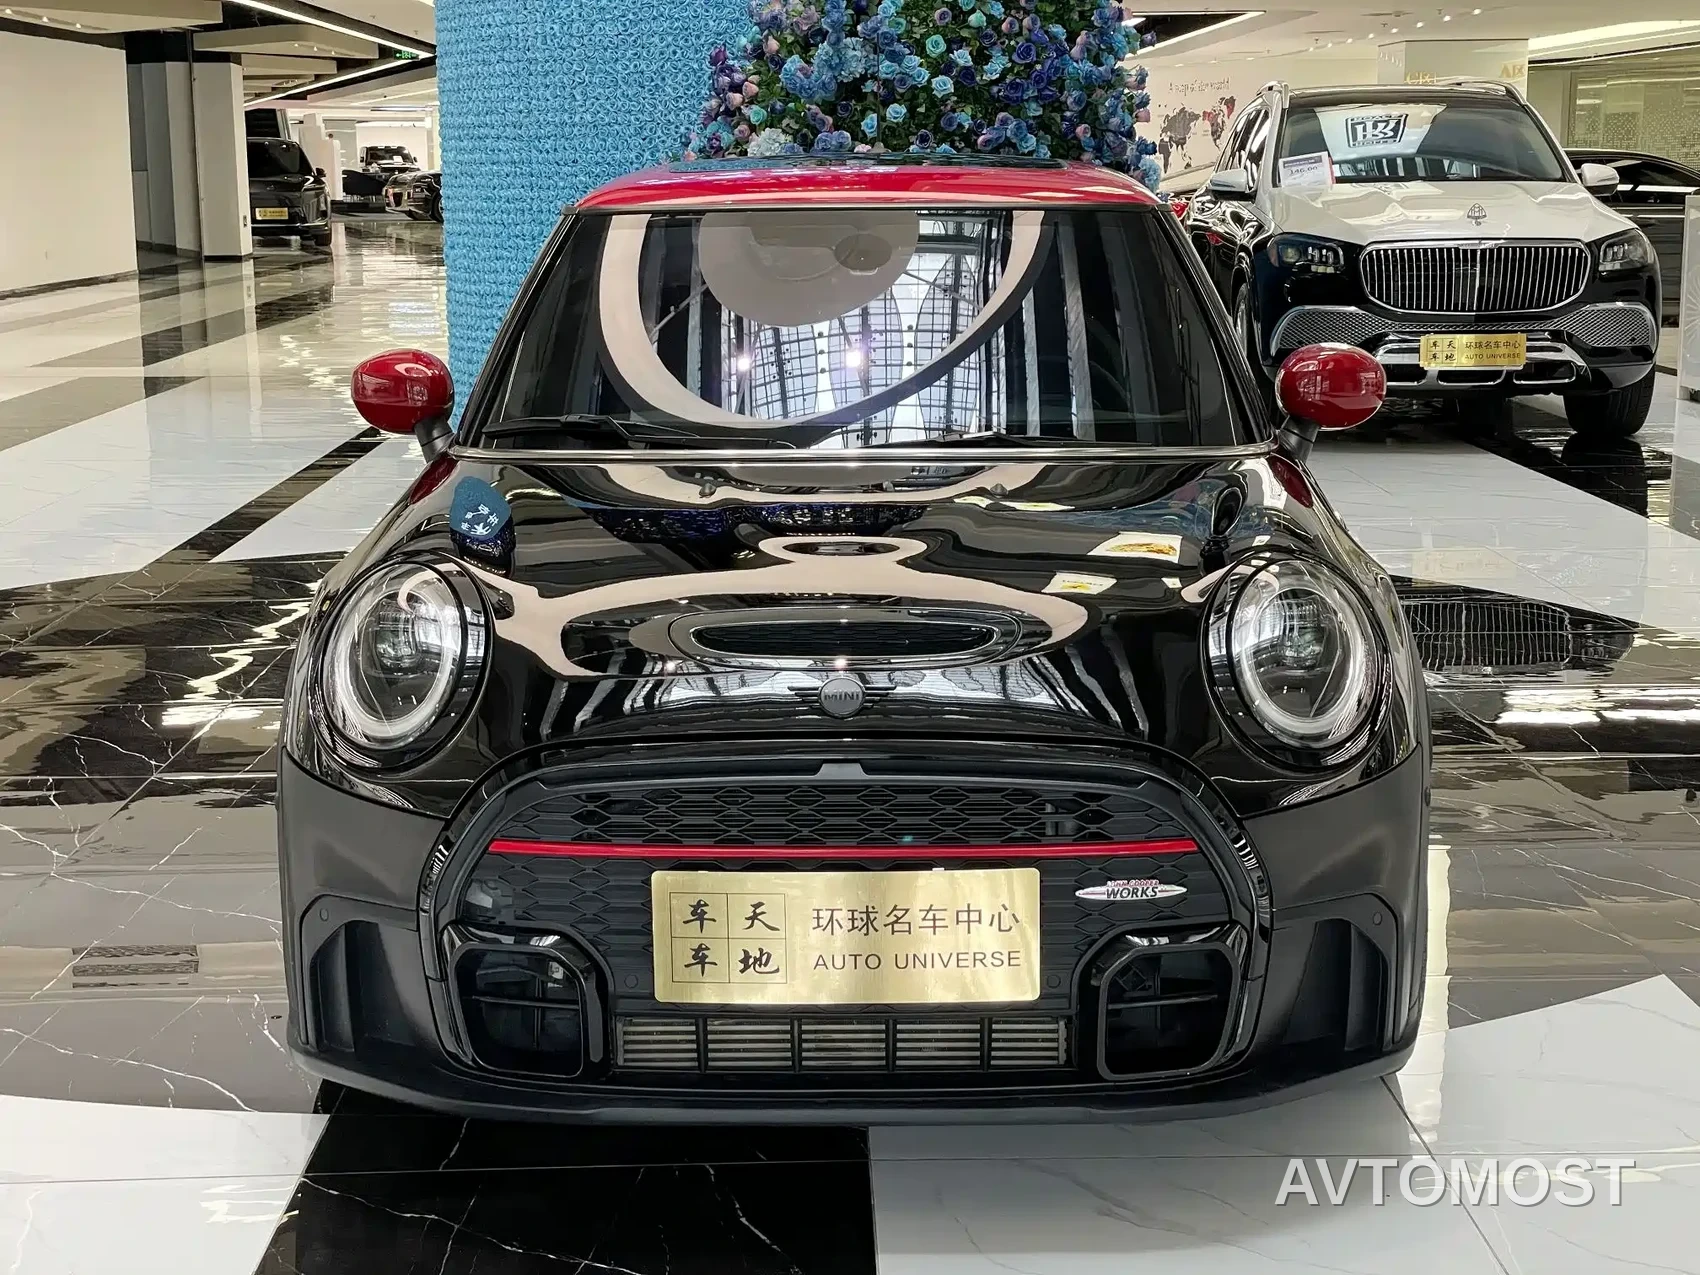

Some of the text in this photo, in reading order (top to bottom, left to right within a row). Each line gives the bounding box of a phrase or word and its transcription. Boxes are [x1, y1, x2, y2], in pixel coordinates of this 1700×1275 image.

[1465, 340, 1520, 350] 环球名车中心
[1486, 352, 1520, 360] UNIVERSE
[824, 689, 860, 701] MINI
[1106, 886, 1158, 899] WORKS
[812, 903, 1020, 936] 环球名车中心
[813, 950, 1021, 971] AUTO UNIVERSE
